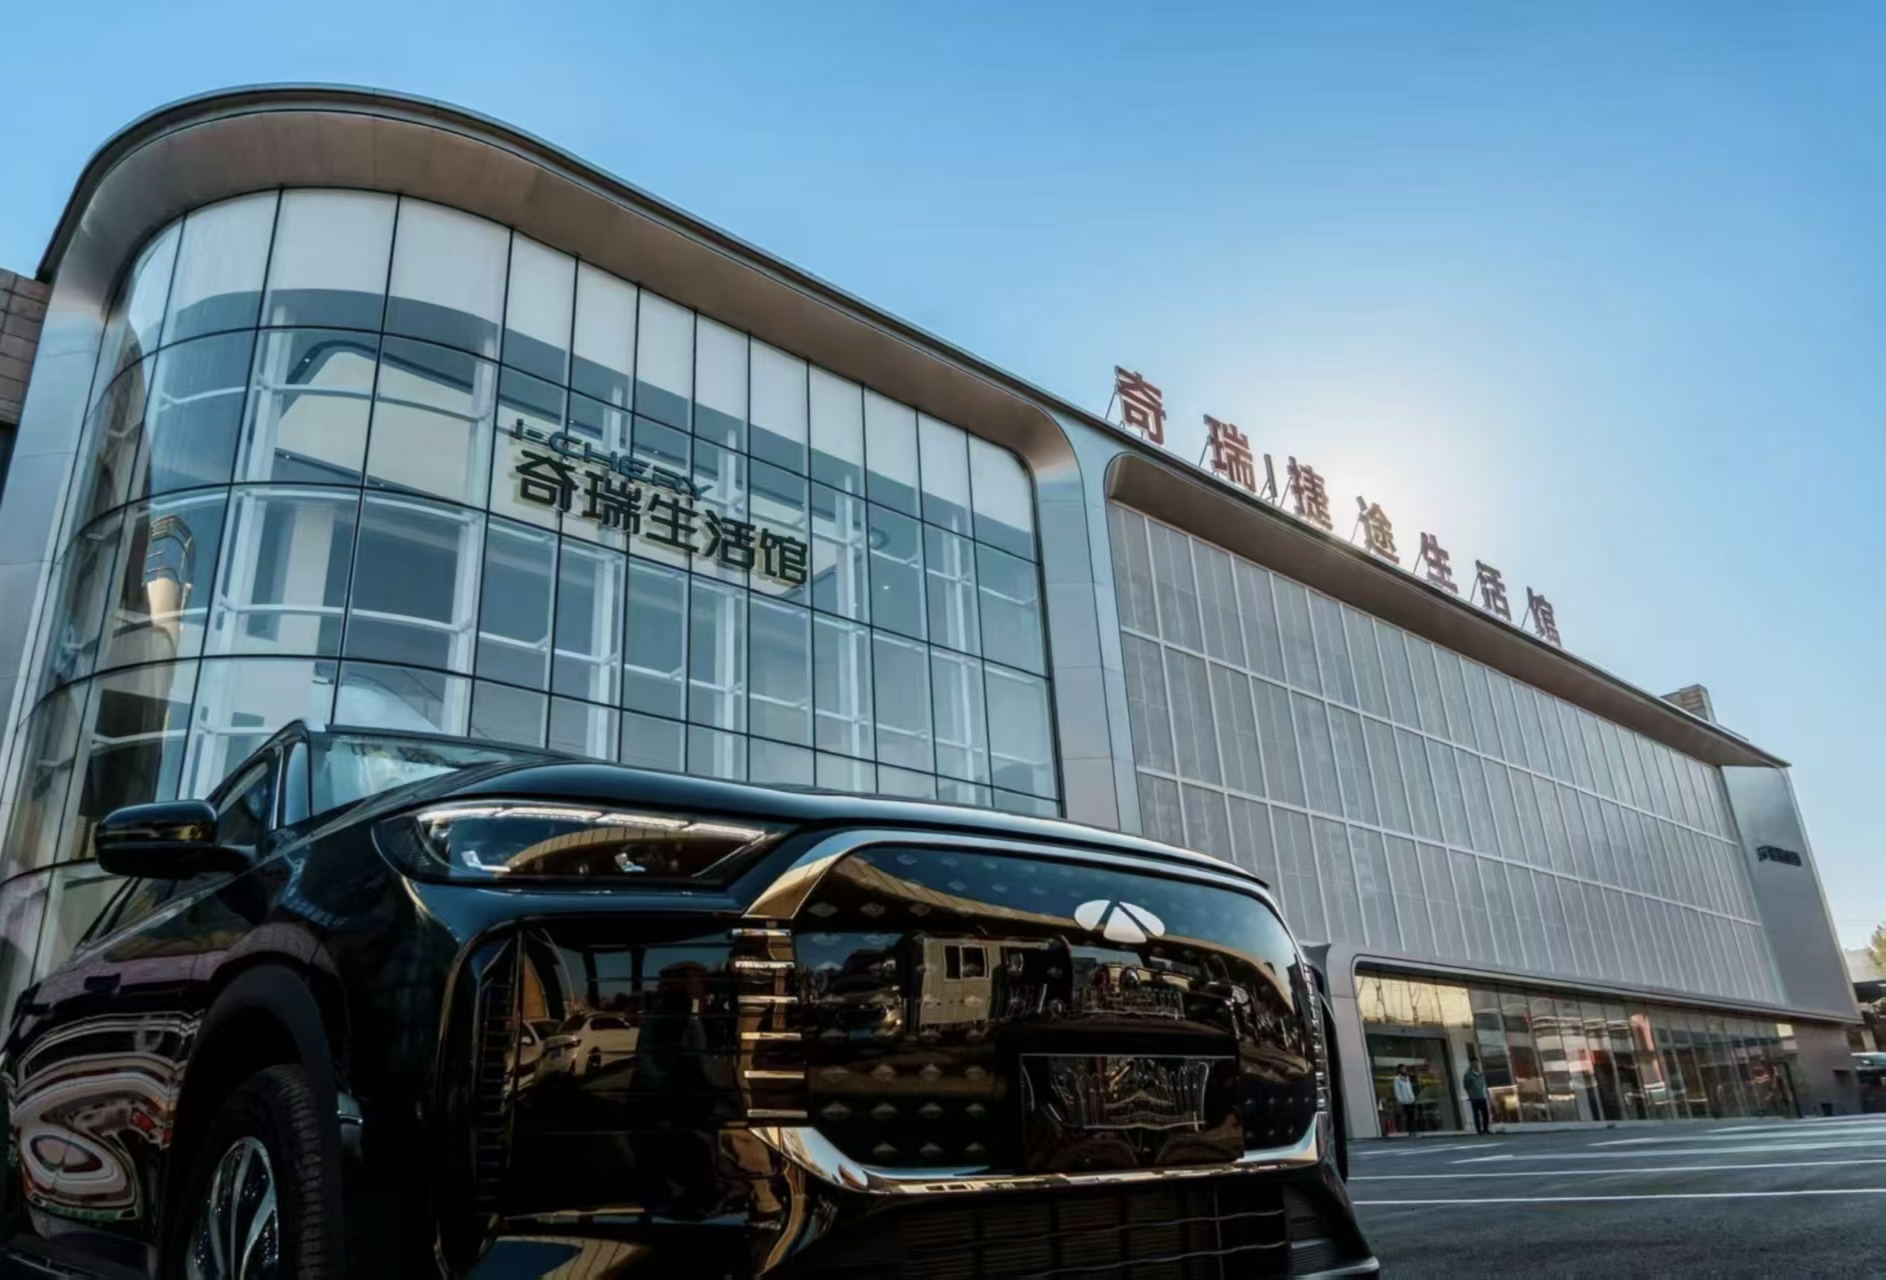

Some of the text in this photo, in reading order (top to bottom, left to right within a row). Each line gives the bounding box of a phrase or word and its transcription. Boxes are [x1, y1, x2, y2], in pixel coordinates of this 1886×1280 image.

[515, 450, 808, 586] 奇瑞生活馆
